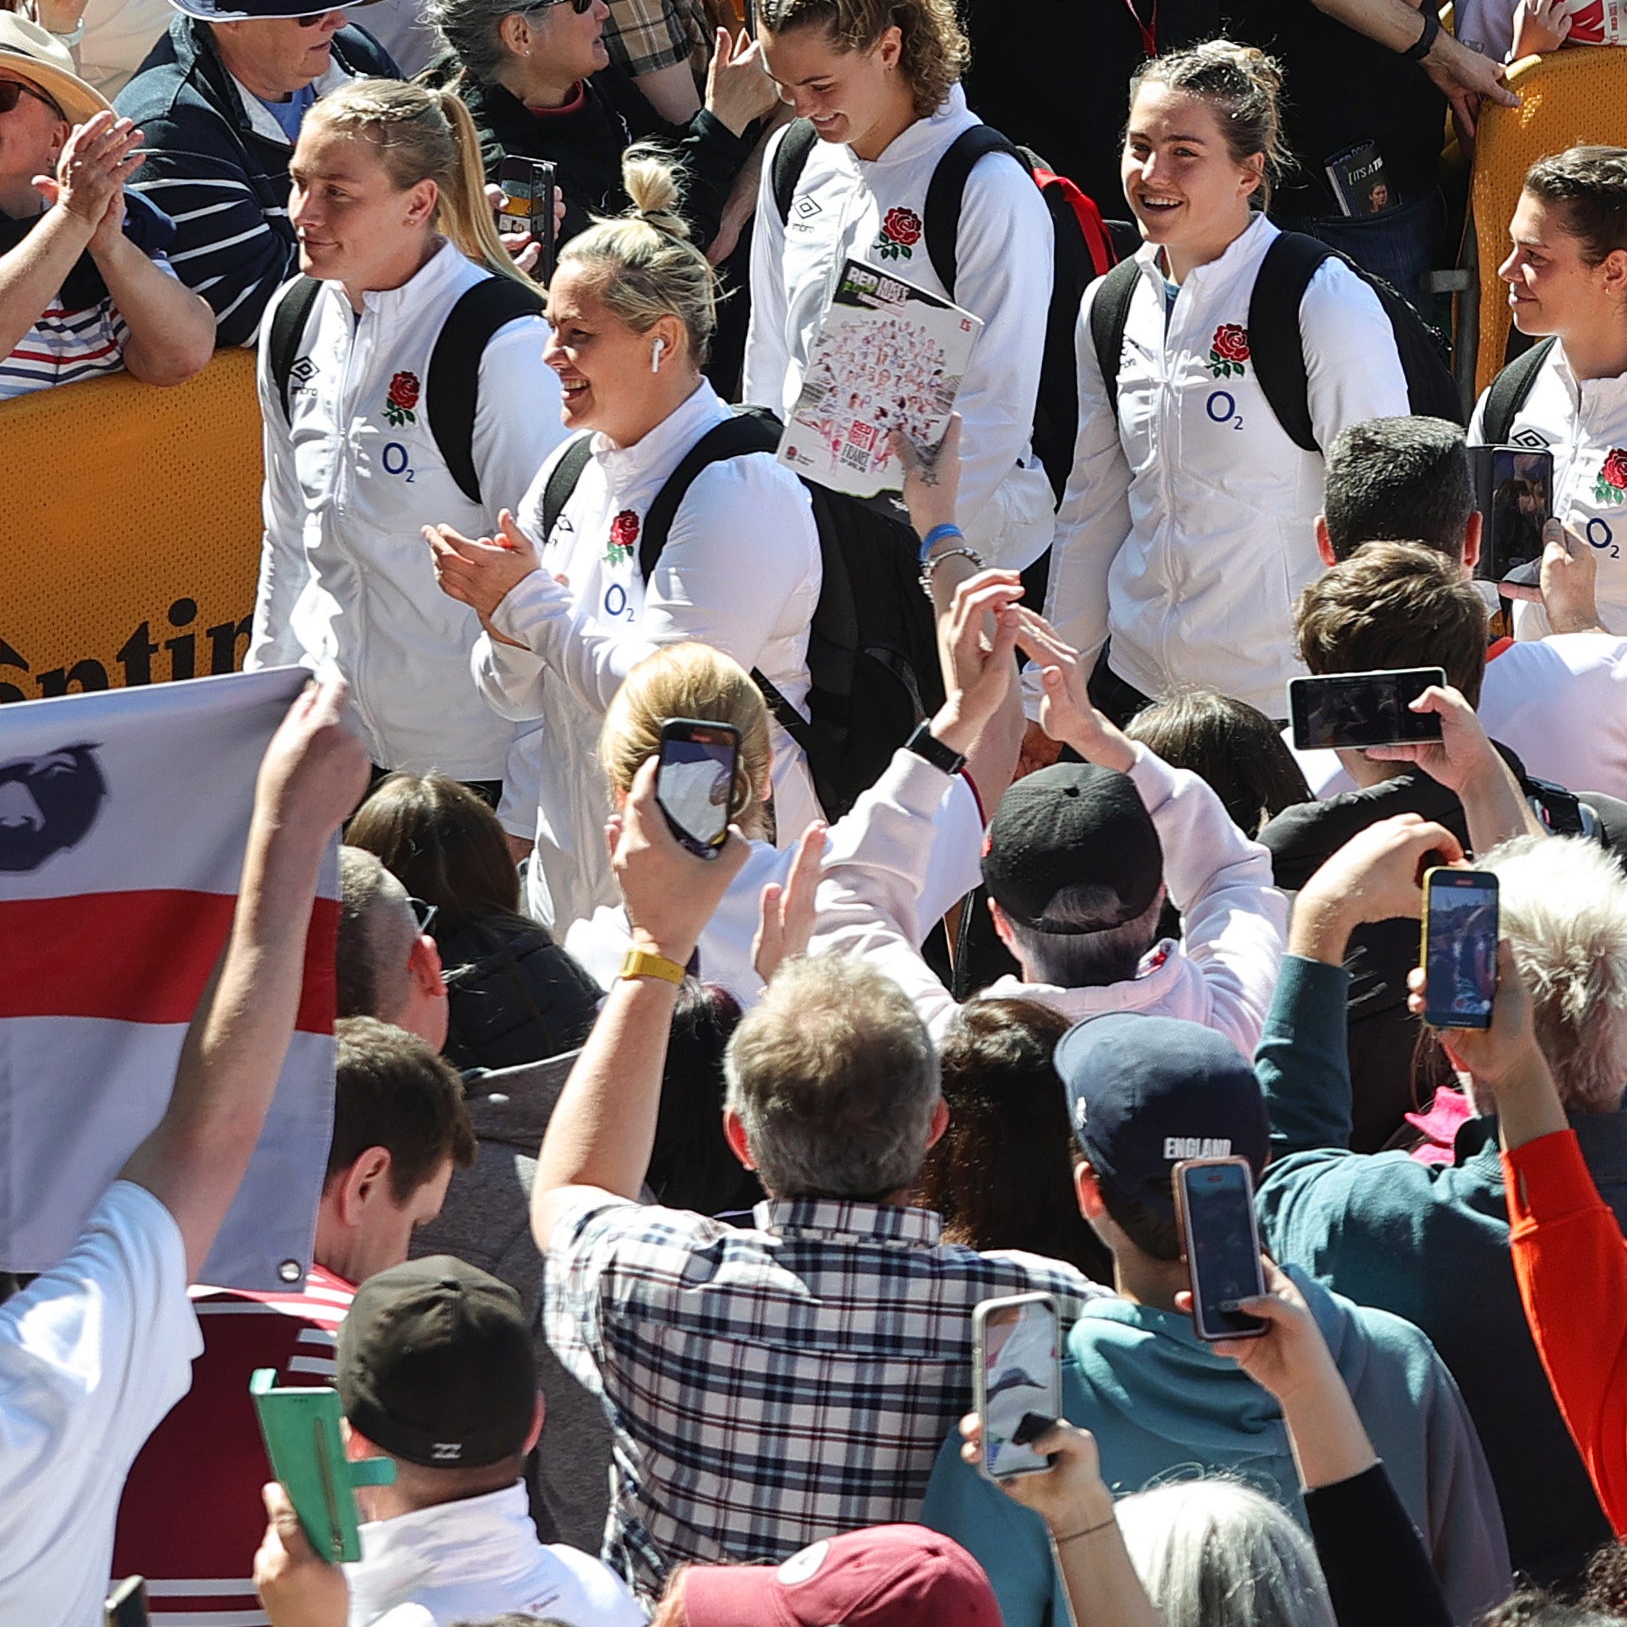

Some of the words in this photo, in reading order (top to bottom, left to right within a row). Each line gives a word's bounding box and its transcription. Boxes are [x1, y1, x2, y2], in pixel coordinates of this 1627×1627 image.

[1206, 390, 1244, 431] O2
[382, 442, 415, 483] O2
[1585, 517, 1620, 559] O2
[605, 583, 635, 622] O2
[1163, 1136, 1232, 1160] ENGLAND
